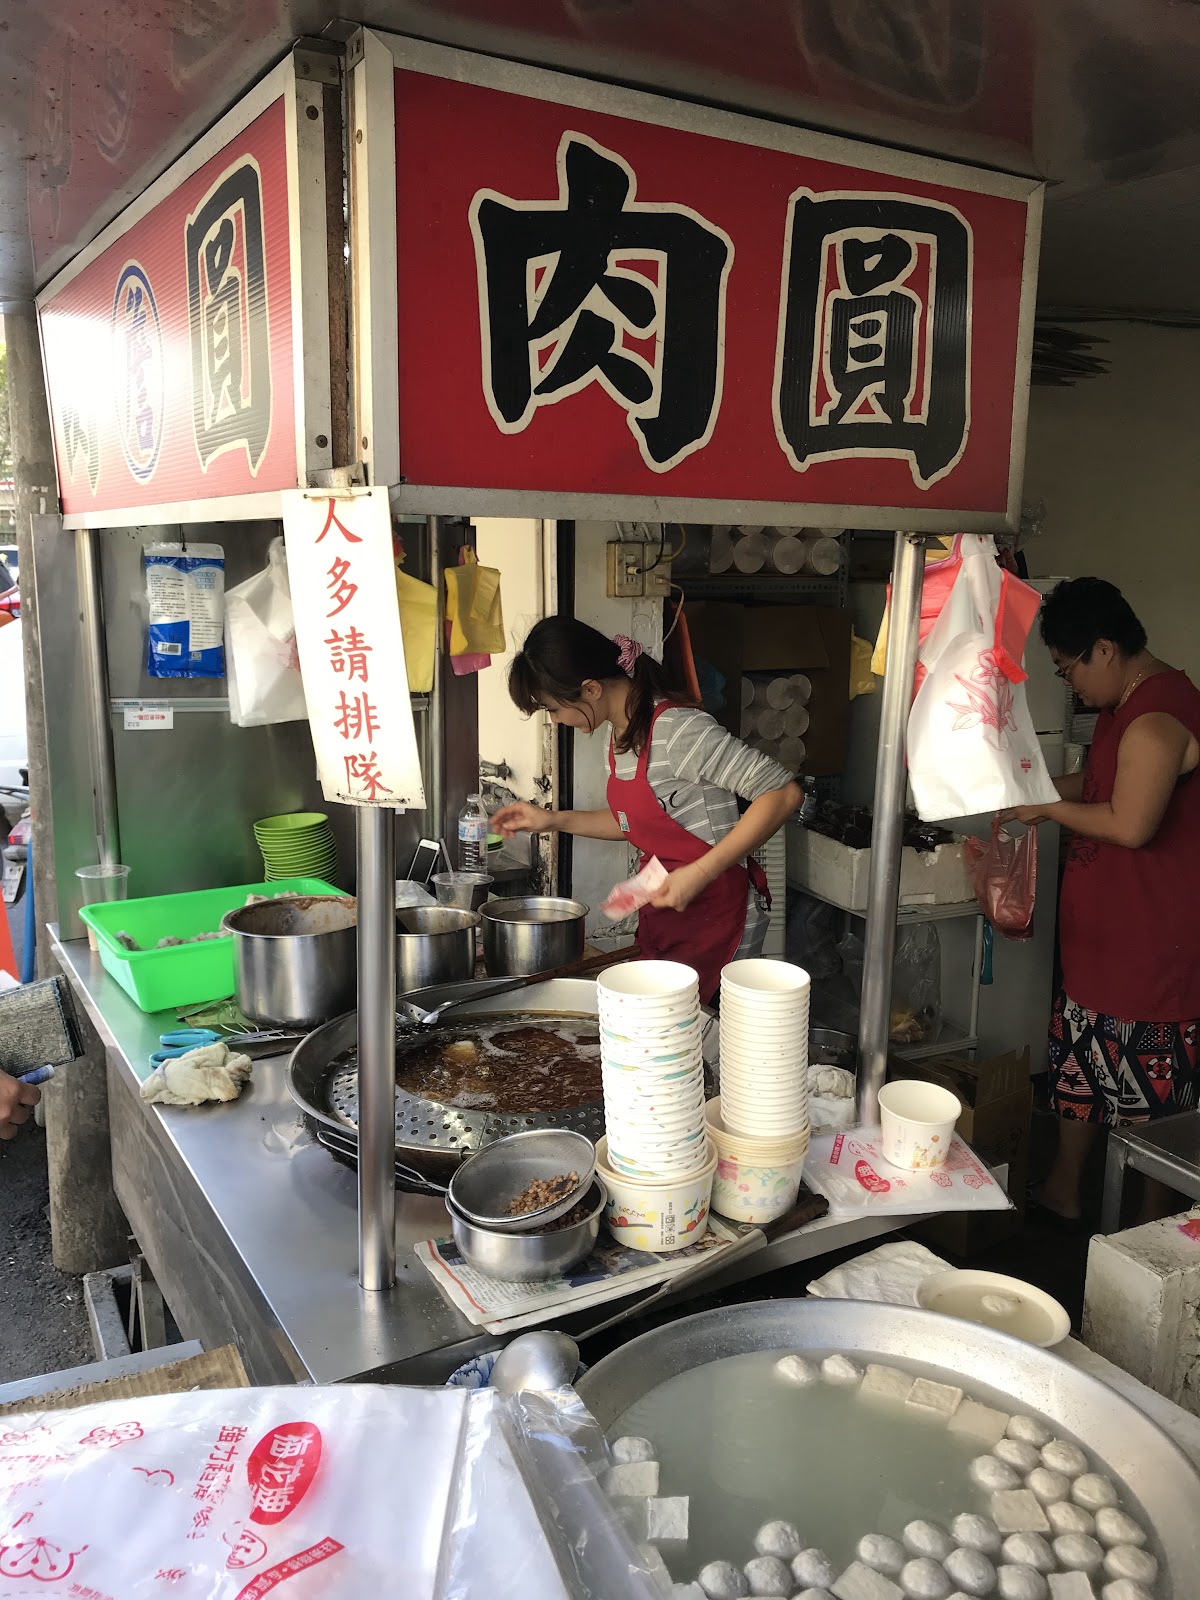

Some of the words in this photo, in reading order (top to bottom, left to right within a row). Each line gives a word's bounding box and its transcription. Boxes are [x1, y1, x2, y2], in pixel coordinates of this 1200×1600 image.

[185, 153, 272, 478] 圓
[470, 131, 972, 489] 肉圓
[315, 498, 393, 799] 人多請排隊
